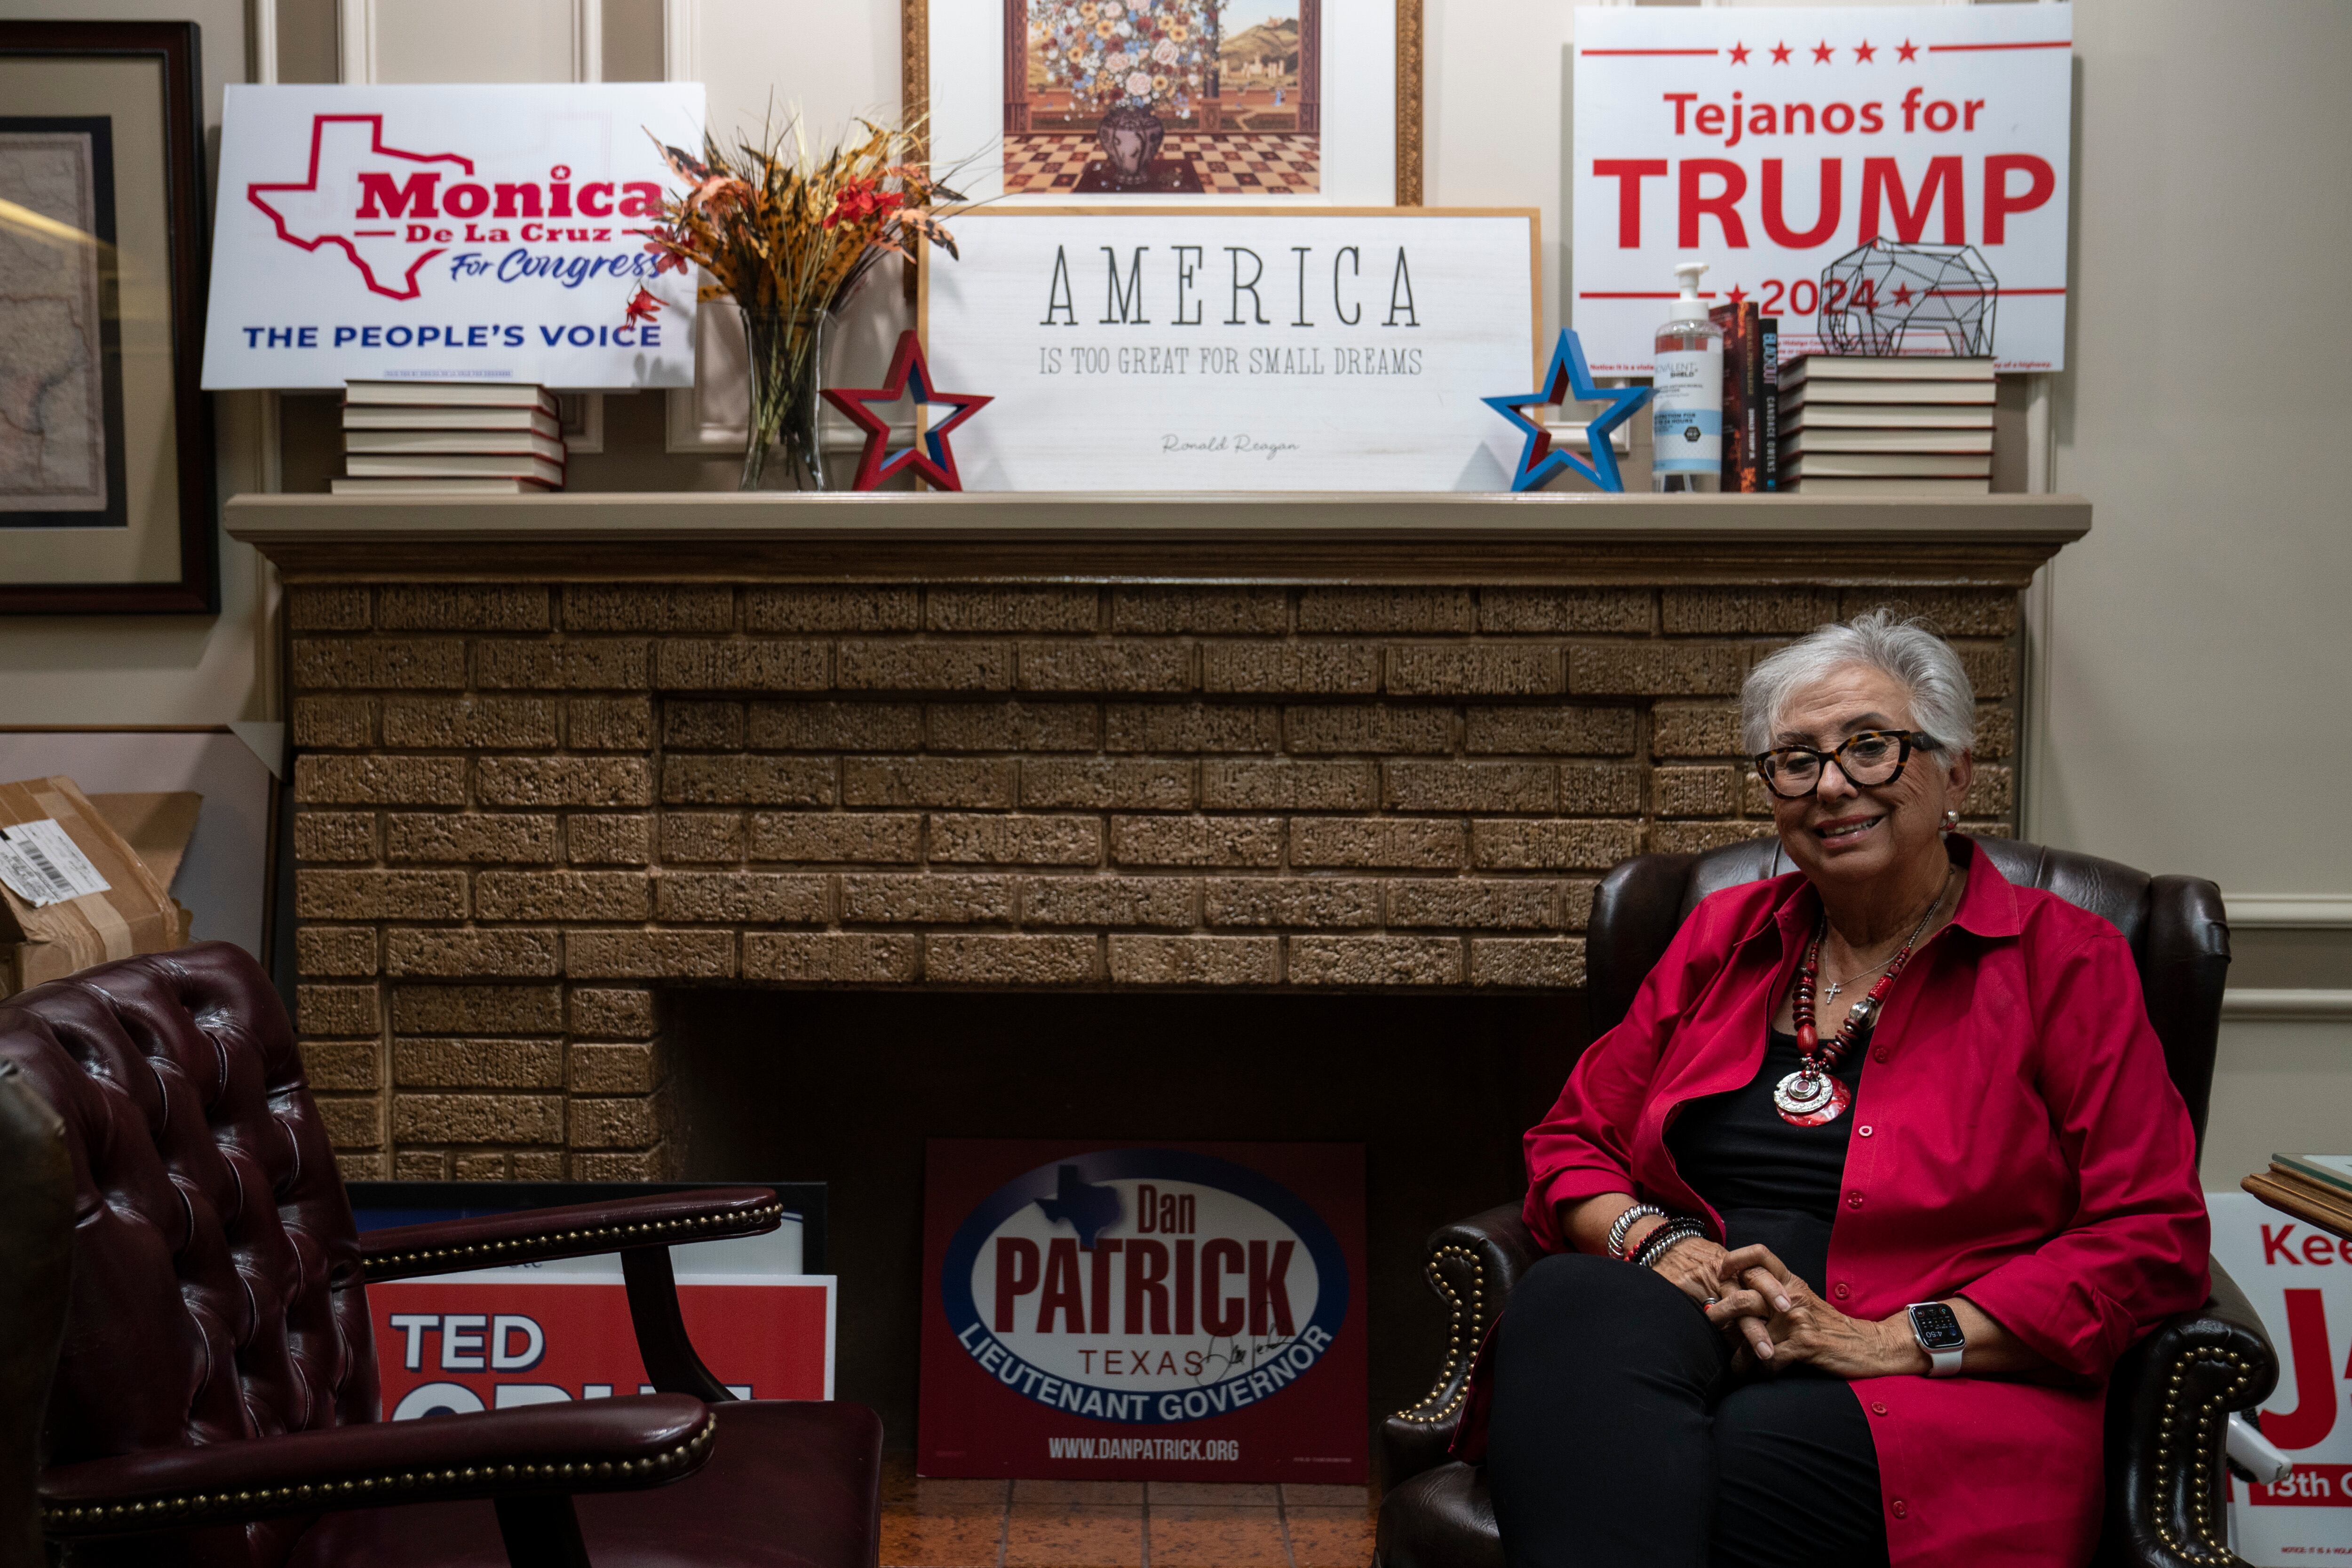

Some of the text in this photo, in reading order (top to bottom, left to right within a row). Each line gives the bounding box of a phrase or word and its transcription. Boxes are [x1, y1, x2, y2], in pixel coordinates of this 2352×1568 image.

[1663, 87, 1985, 148] Tejanos for
[355, 165, 664, 219] Monica
[1592, 153, 2056, 250] TRUMP
[405, 223, 612, 243] De La Cruz
[450, 247, 662, 288] For Congress
[1039, 244, 1422, 327] AMERICA
[1761, 279, 1879, 317] 2024
[243, 325, 662, 349] THE PEOPLE'S VOICE
[1039, 346, 1422, 375] IS TOO GREAT FOR SMALL DREAMS
[1161, 433, 1301, 461] Ronald Reagan
[1137, 1184, 1196, 1234] Dan
[994, 1236, 1297, 1337] PATRICK
[389, 1313, 547, 1373] TED
[1078, 1349, 1204, 1377] TEXAS
[957, 1321, 1150, 1420] LIEUTENANT
[1158, 1323, 1334, 1420] GOVERNOR
[1049, 1437, 1240, 1461] WWW.DANPATRICK.ORG
